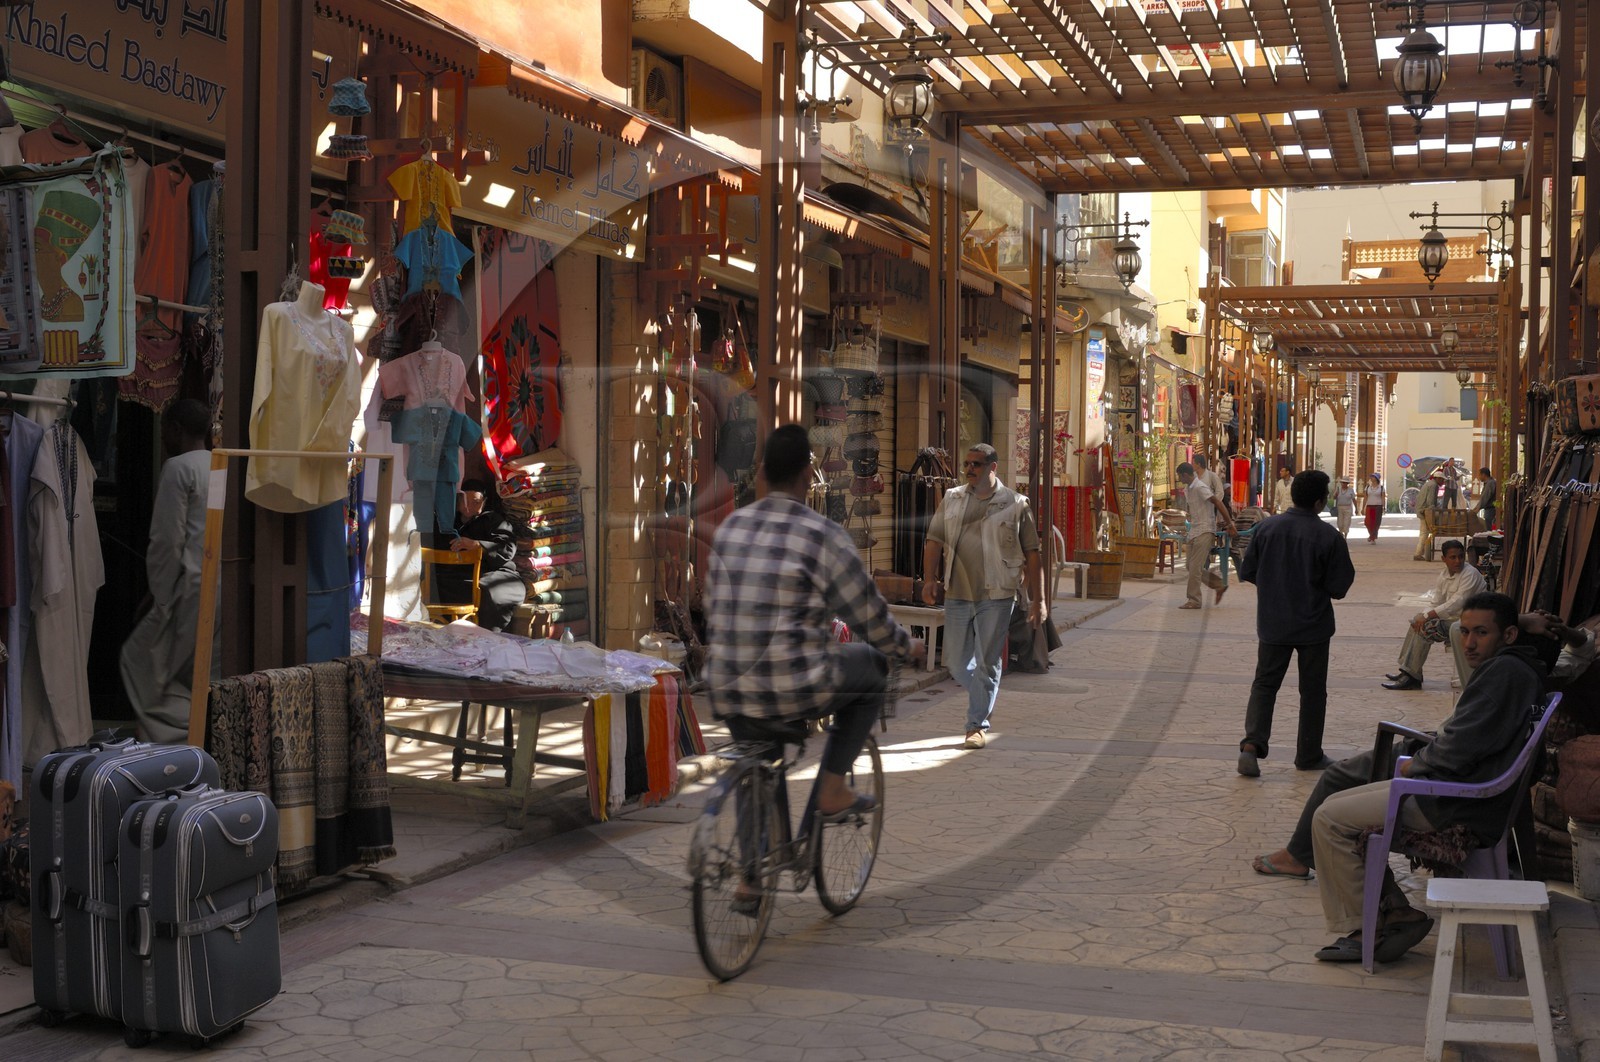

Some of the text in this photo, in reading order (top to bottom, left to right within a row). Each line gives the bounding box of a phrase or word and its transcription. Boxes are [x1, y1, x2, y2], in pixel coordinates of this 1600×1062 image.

[5, 2, 111, 73] Khaled
[121, 39, 227, 122] Bastawy
[582, 137, 641, 202] كامل
[521, 185, 630, 246] Kamel Ellias
[184, 919, 212, 934] KIKA
